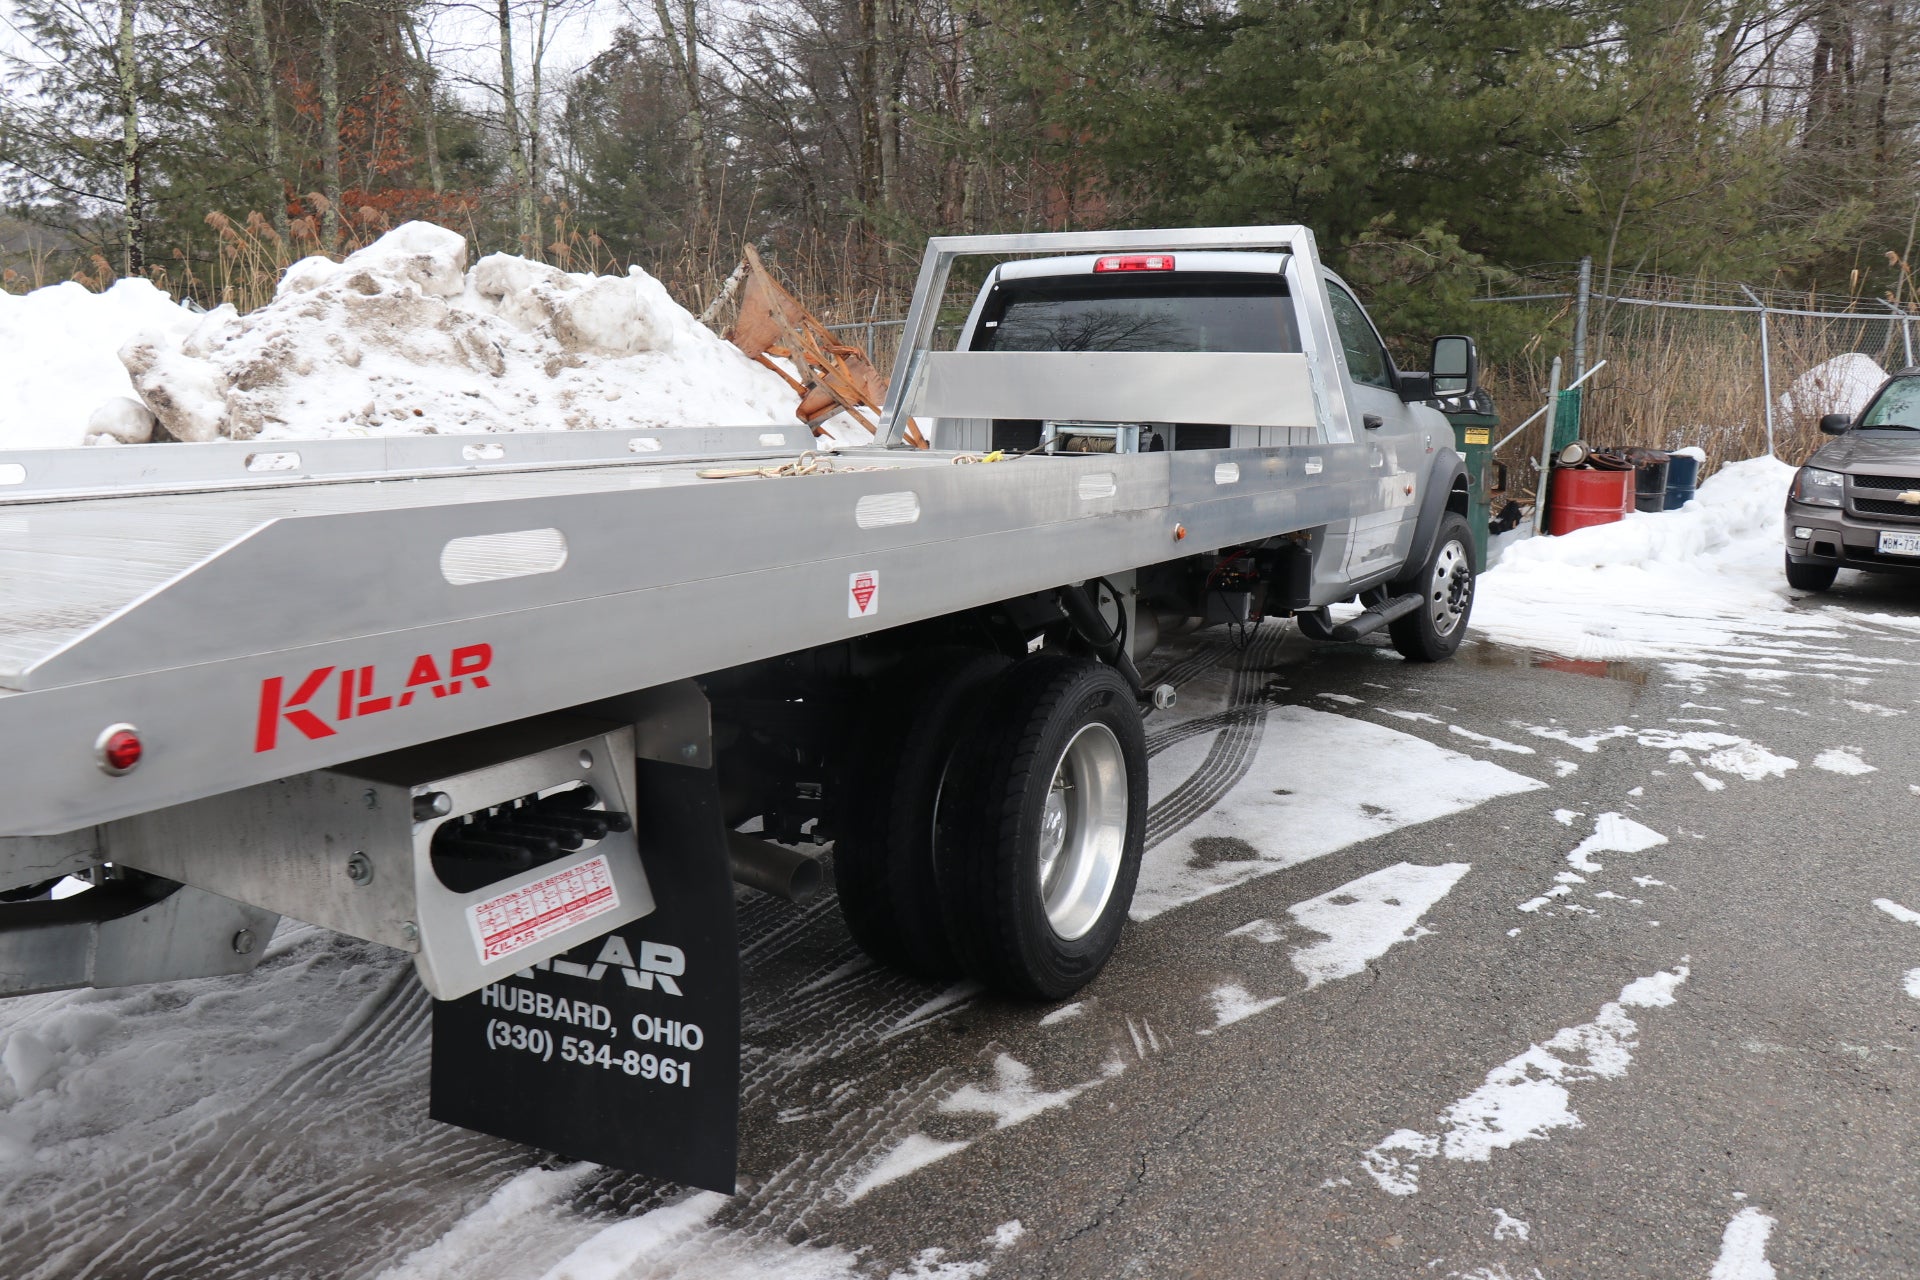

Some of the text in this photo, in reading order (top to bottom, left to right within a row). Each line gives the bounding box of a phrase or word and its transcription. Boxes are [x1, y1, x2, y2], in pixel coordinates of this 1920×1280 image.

[253, 643, 493, 753] KILAR
[475, 858, 603, 913] CAUTION: SLIDE BEFORE TILTING
[484, 930, 535, 961] KILAR
[481, 982, 705, 1051] HUBBARD, OHIO
[486, 1018, 691, 1088] (330) 534-8961
